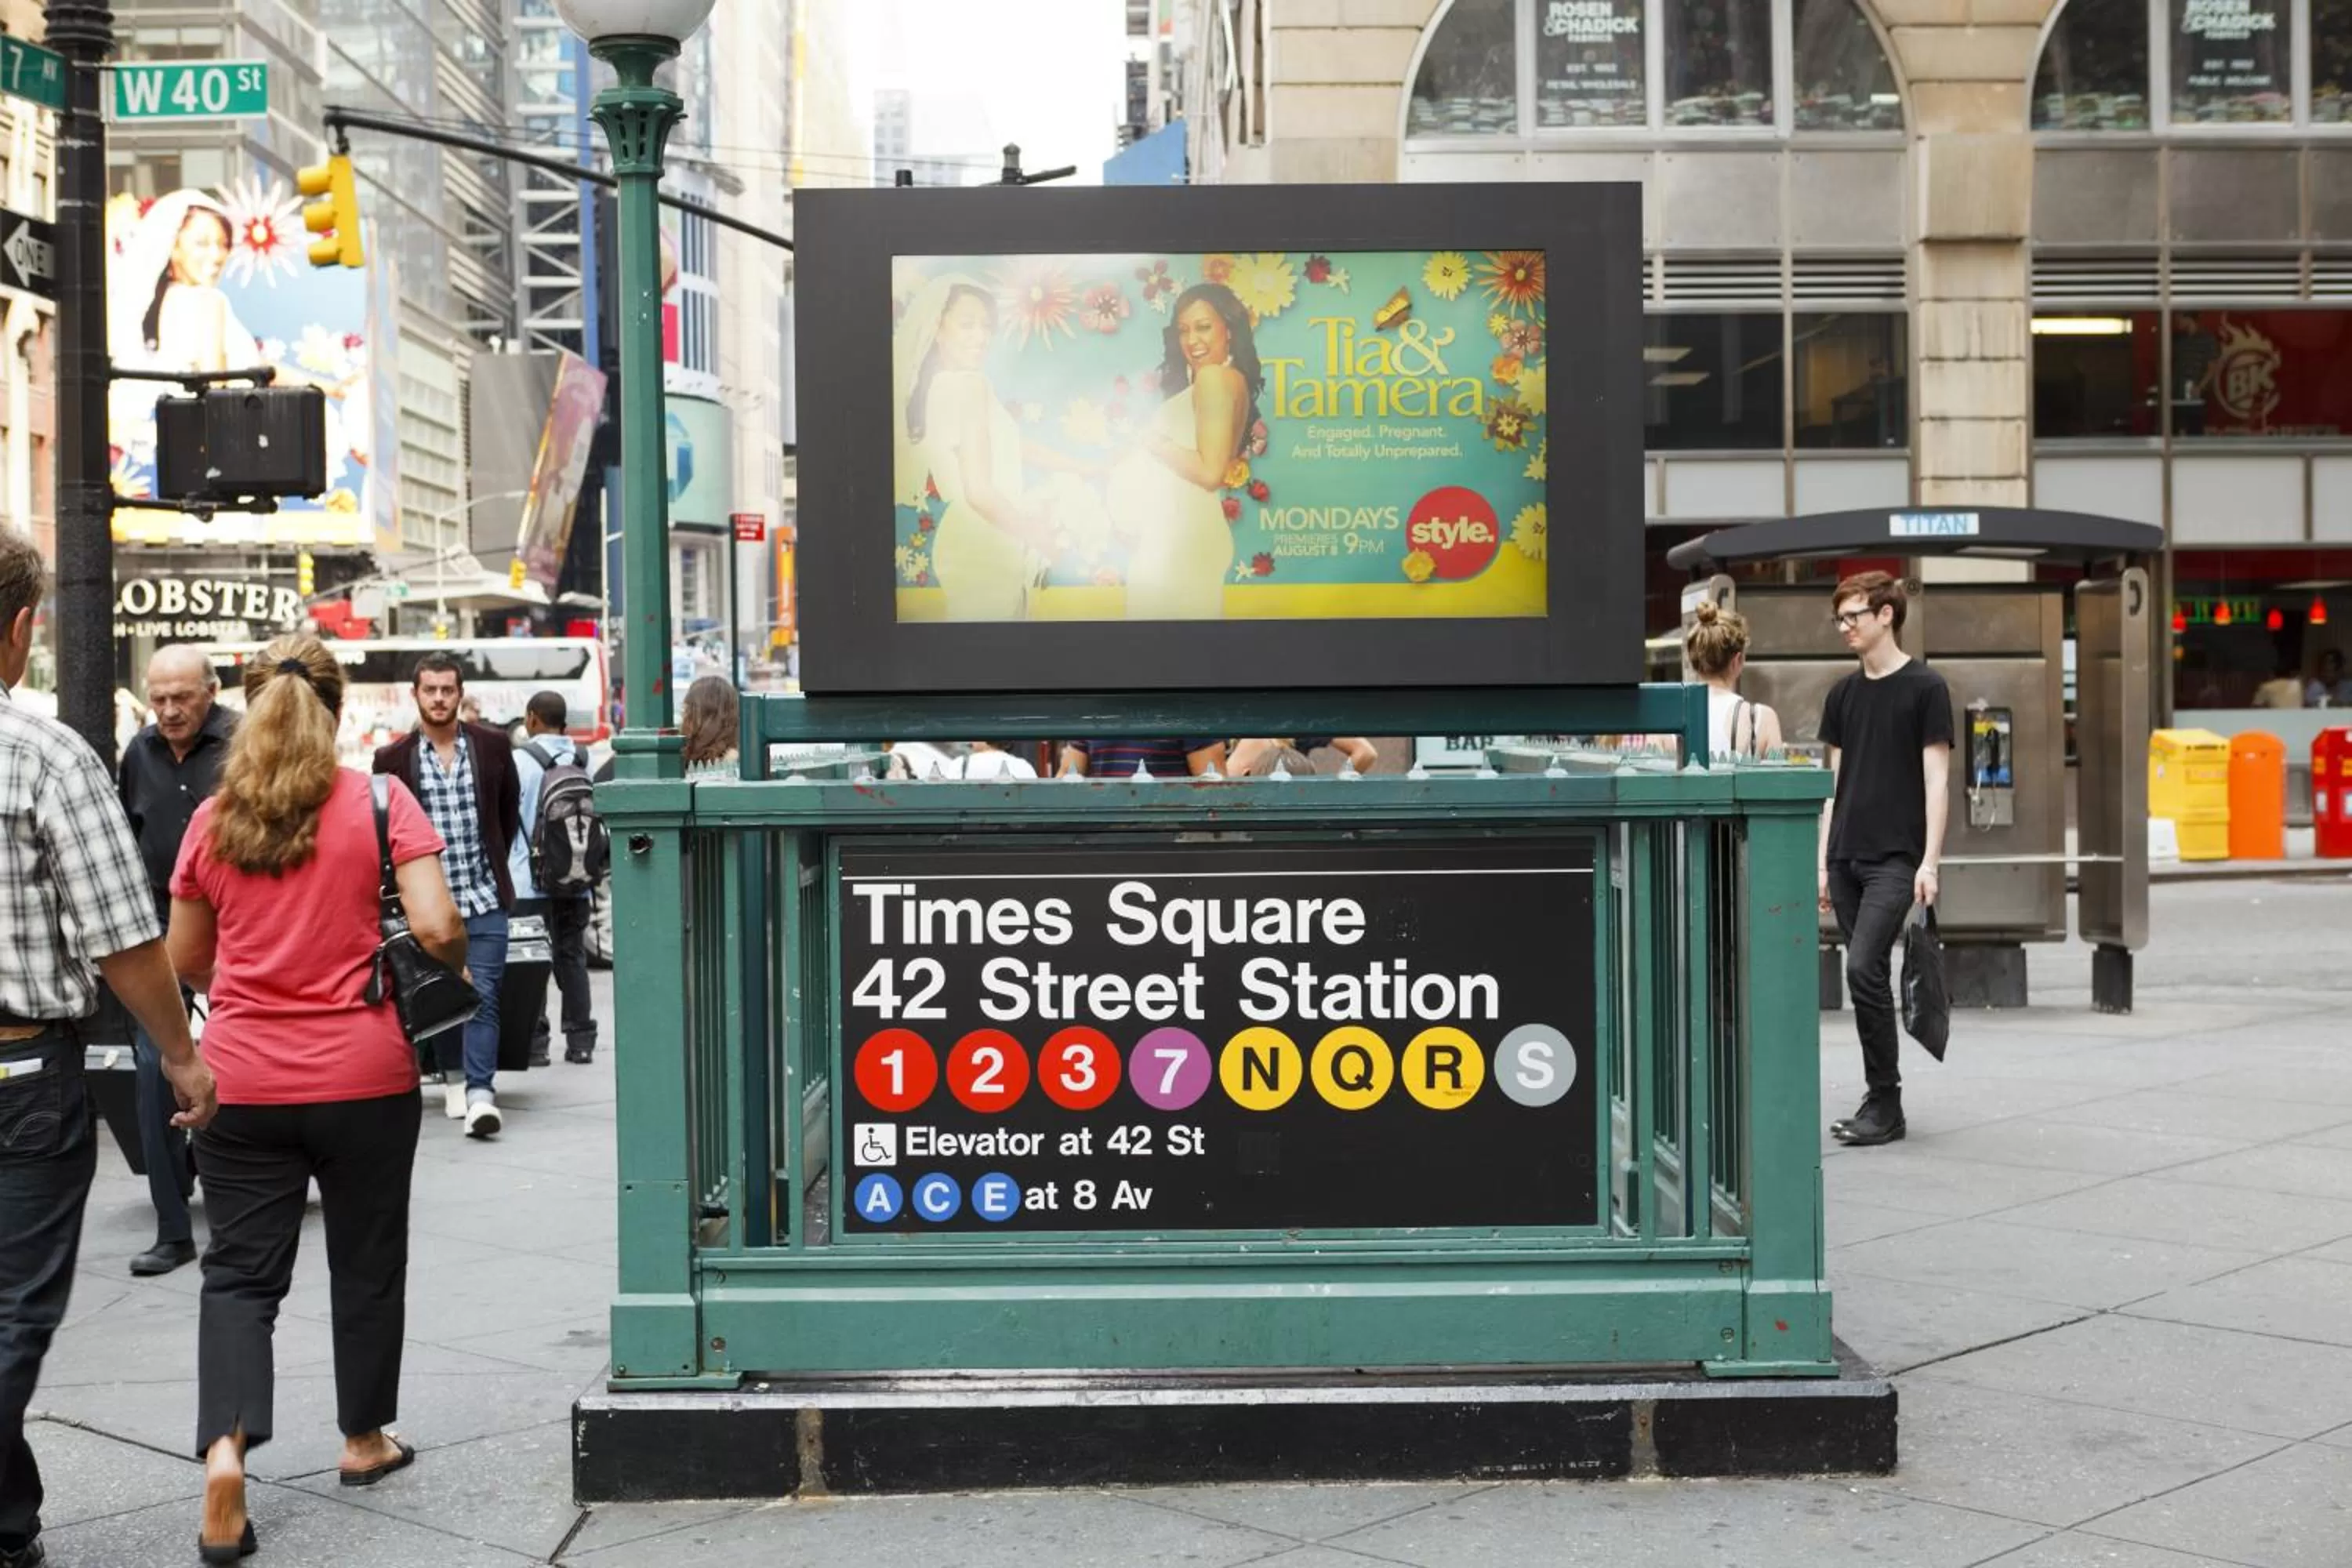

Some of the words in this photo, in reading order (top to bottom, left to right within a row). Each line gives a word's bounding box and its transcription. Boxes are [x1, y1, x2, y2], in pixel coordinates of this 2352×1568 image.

[1549, 2, 1613, 17] ROSEN
[9, 45, 24, 89] 7
[122, 71, 163, 114] W
[172, 68, 229, 112] 40
[238, 67, 262, 92] St
[16, 238, 45, 273] ONE
[1260, 358, 1484, 419] Tamera
[1307, 425, 1374, 443] Engaged.
[1379, 425, 1447, 443] Pregnant.
[1291, 445, 1322, 459] And
[1326, 445, 1370, 461] Totally
[1374, 445, 1464, 461] Unprepared.
[1259, 507, 1400, 531] MONDAYS
[1412, 517, 1495, 549] style.
[1900, 514, 1968, 534] TITAN
[1273, 545, 1328, 557] AUGUST
[113, 579, 299, 629] OBSTER
[1445, 735, 1494, 751] BAR
[852, 884, 1073, 946] Times
[1106, 880, 1366, 957] Square
[852, 956, 947, 1019] 42
[979, 956, 1205, 1022] Street
[1239, 956, 1499, 1022] Station
[880, 1051, 905, 1094] 1
[971, 1047, 1004, 1093] 2
[1060, 1045, 1096, 1091] 3
[1153, 1049, 1188, 1094] 7
[1241, 1047, 1280, 1091] N
[1330, 1044, 1374, 1092] Q
[1425, 1045, 1462, 1089] R
[1515, 1041, 1555, 1090] S
[906, 1125, 1045, 1156] Elevator
[1059, 1127, 1093, 1156] at
[1106, 1125, 1152, 1155] 42
[1167, 1124, 1205, 1156] St
[866, 1182, 891, 1213] A
[923, 1181, 949, 1213] C
[983, 1182, 1007, 1212] E
[1025, 1181, 1058, 1210] at
[1073, 1179, 1097, 1210] 8
[1111, 1180, 1153, 1210] Av
